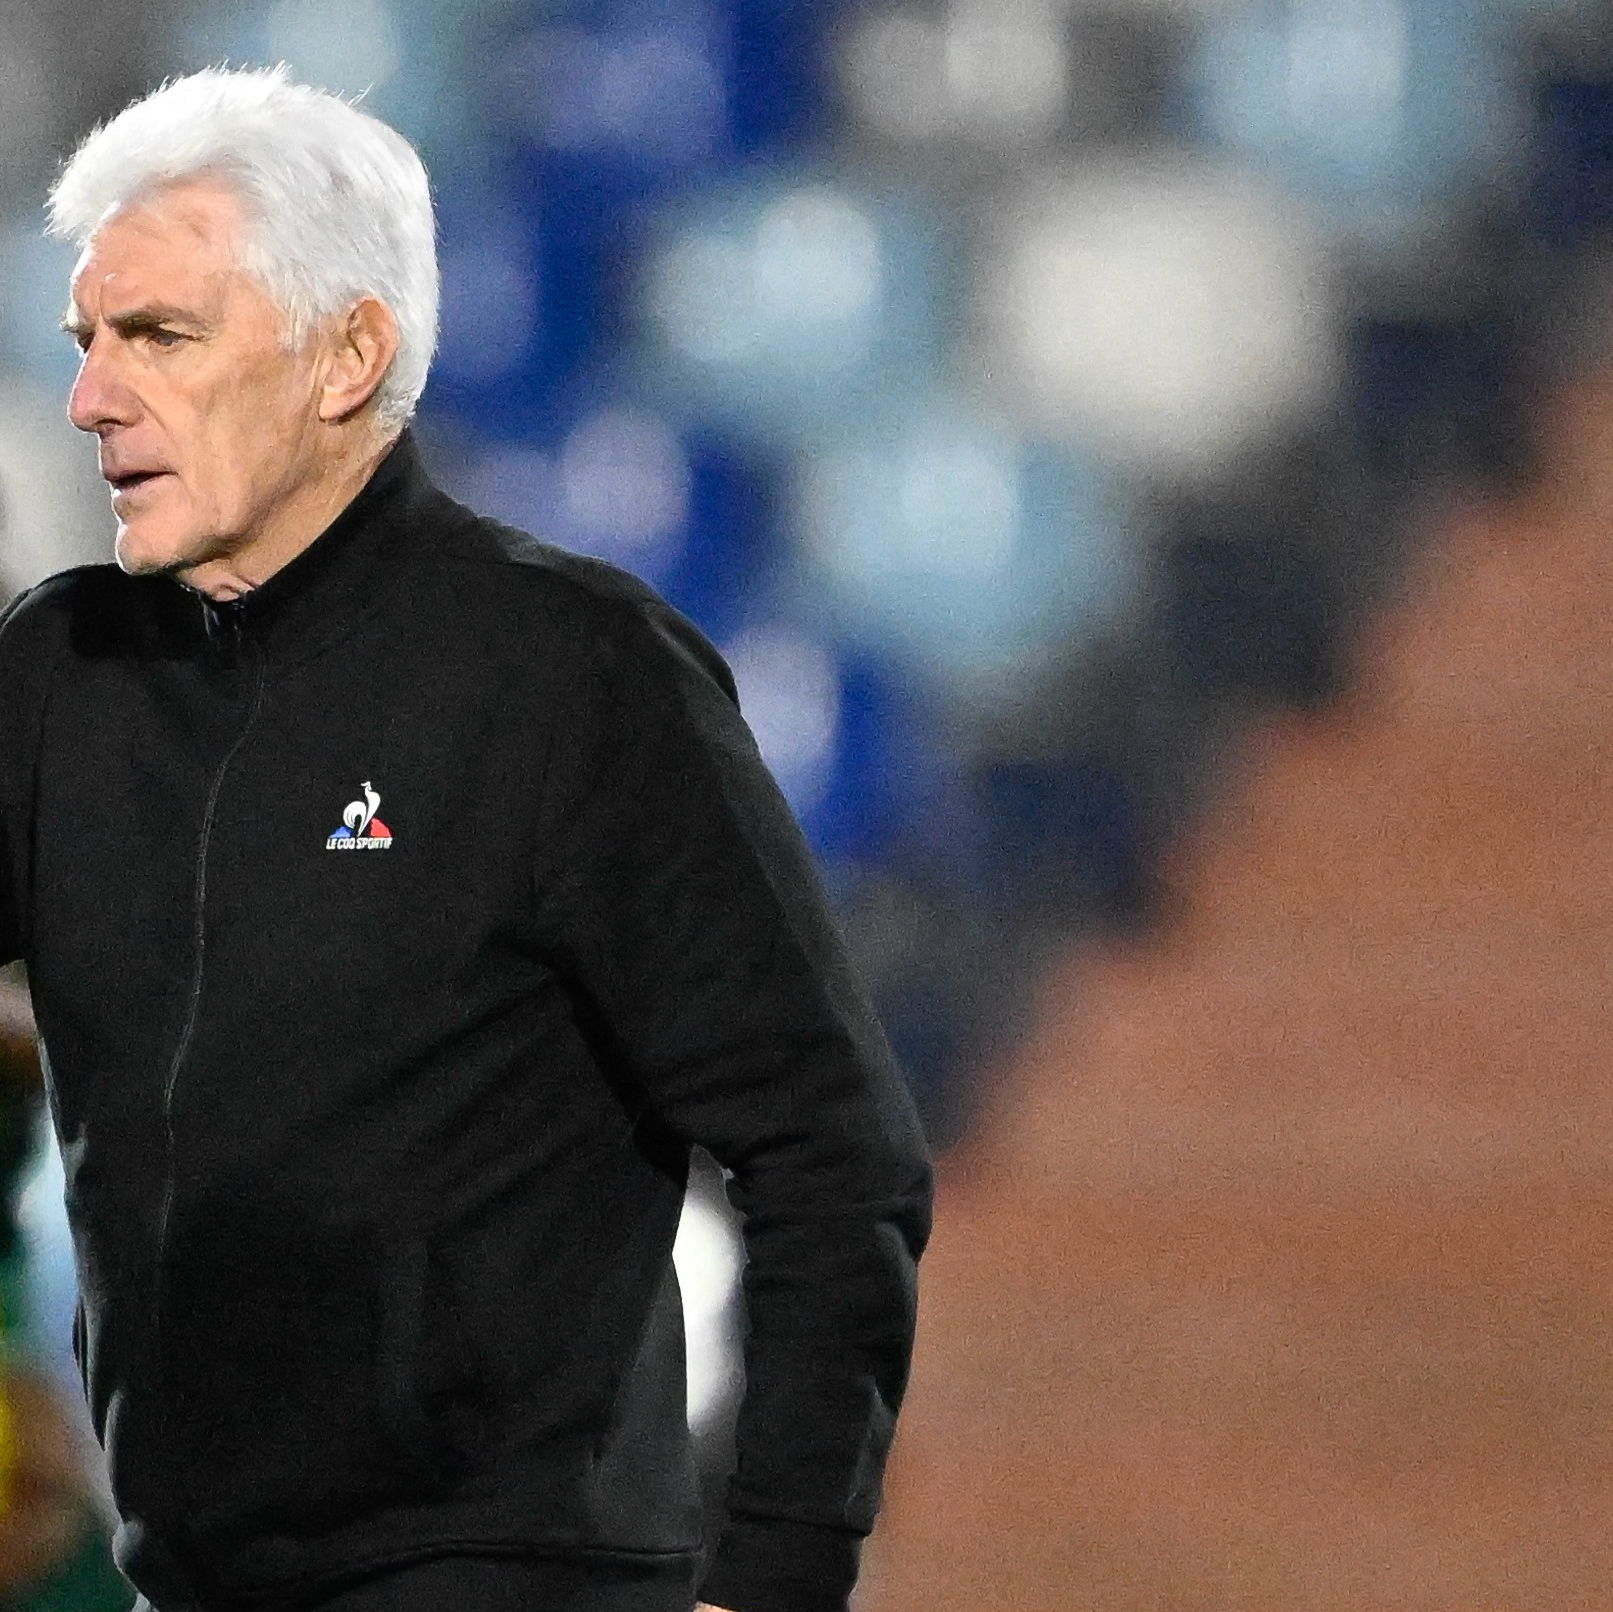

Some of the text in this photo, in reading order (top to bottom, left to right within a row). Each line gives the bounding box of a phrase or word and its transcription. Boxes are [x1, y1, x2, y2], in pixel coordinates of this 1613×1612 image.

[326, 838, 392, 849] LE COQ SPORTIF
